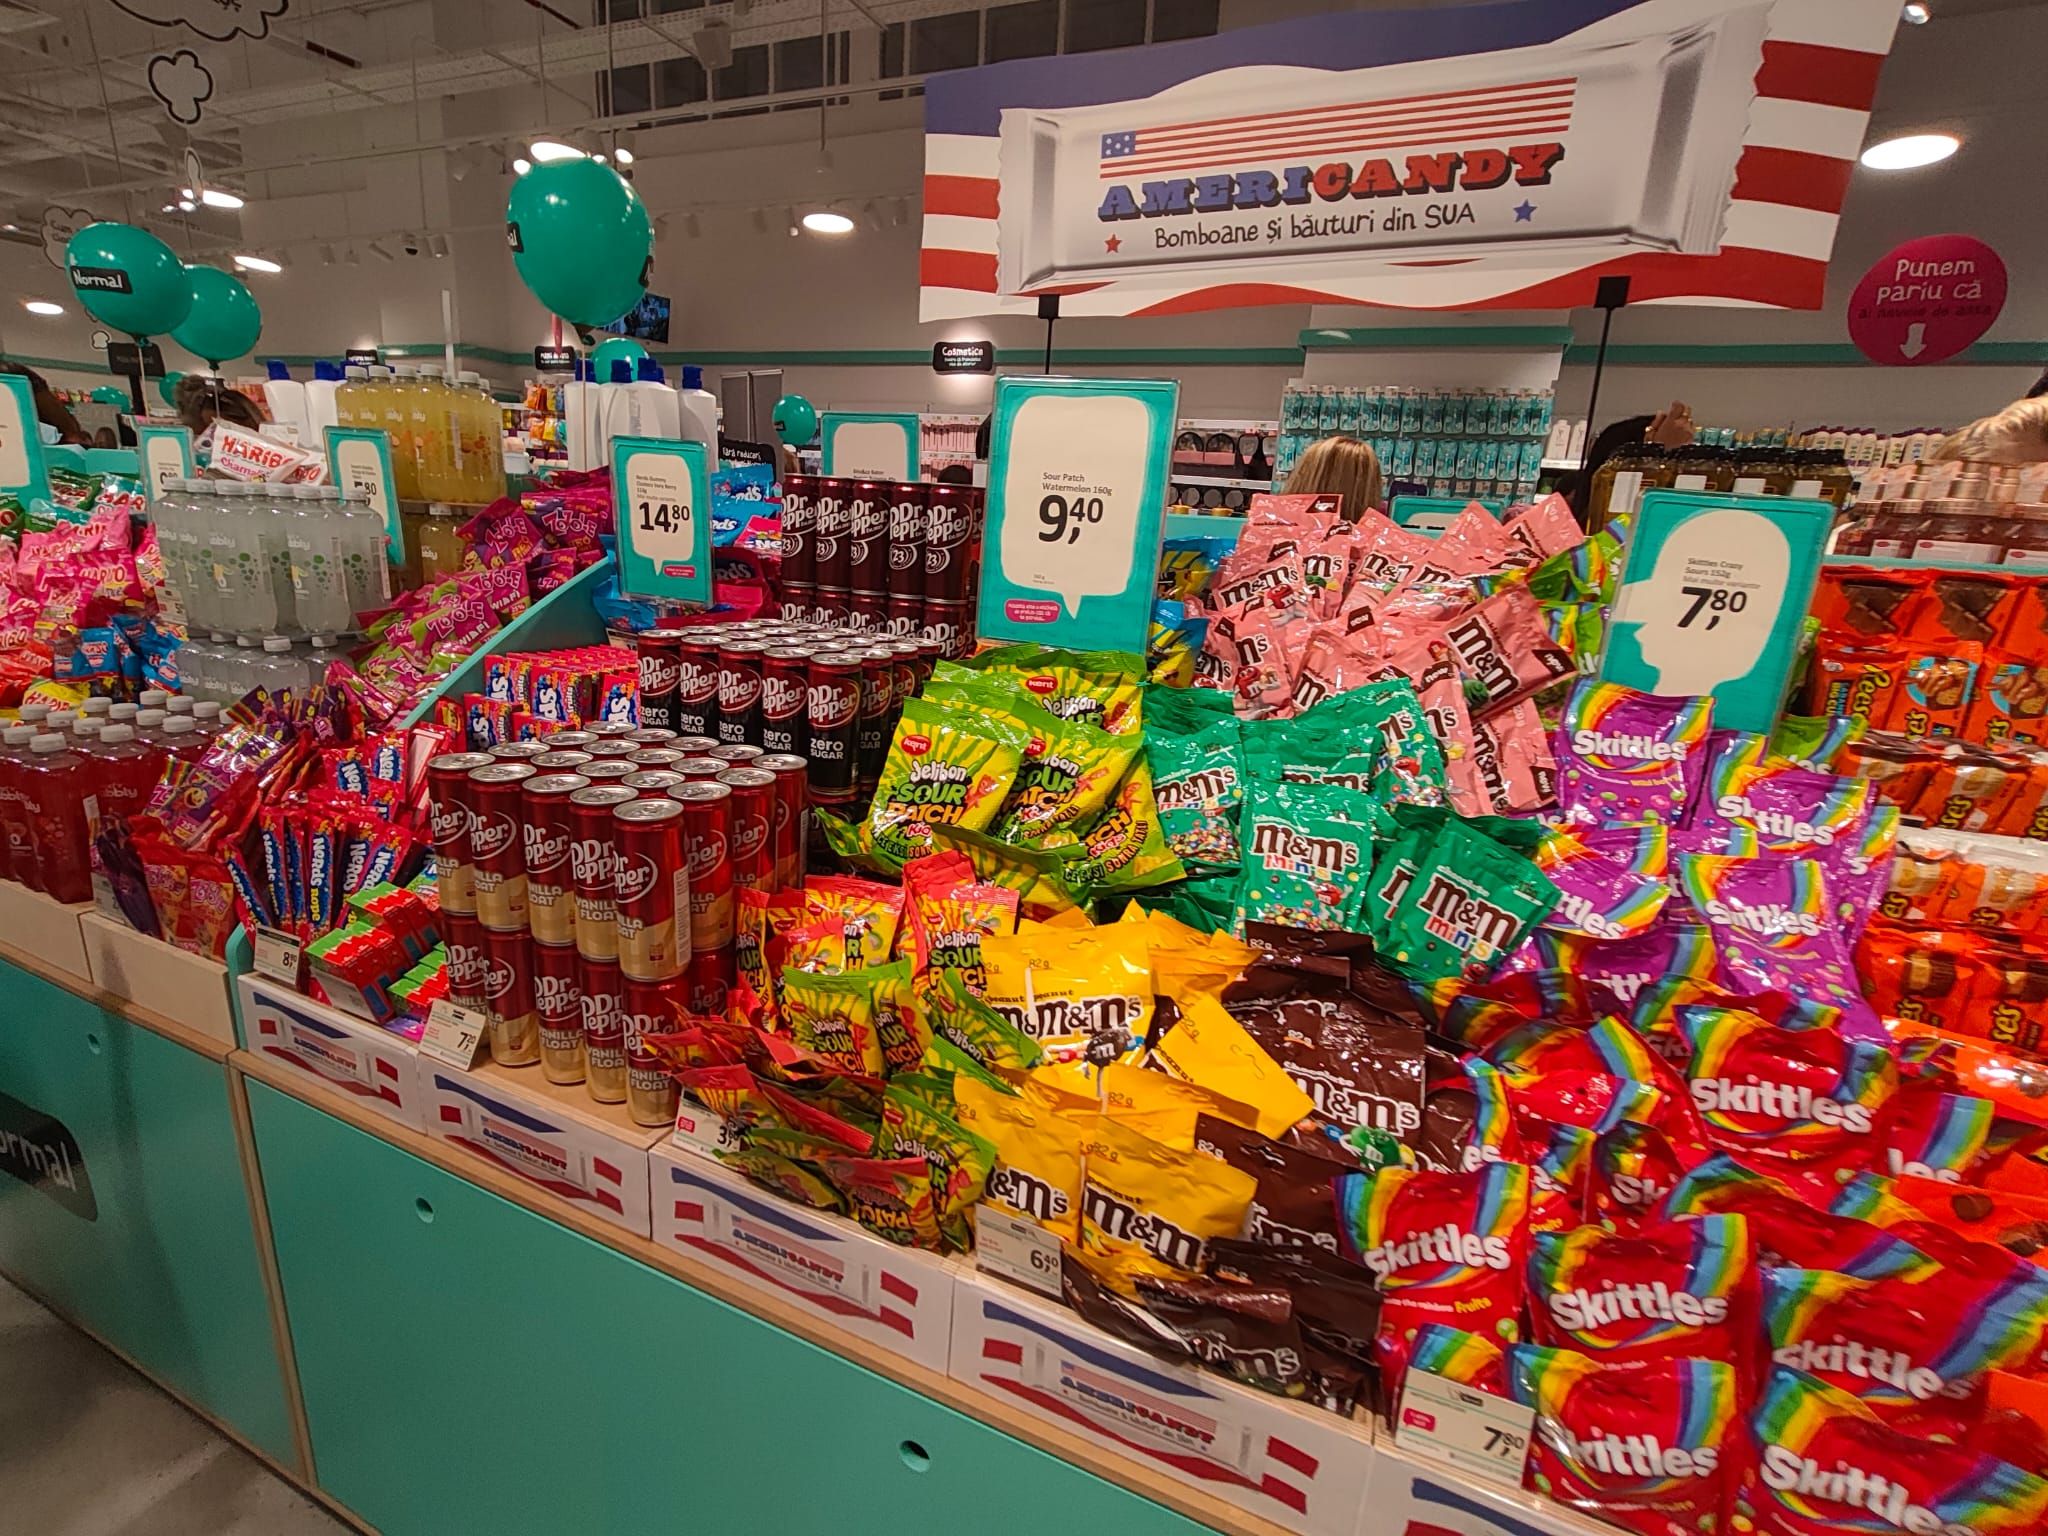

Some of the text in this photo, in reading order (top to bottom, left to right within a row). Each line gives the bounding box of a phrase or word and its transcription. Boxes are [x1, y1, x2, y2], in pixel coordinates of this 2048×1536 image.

[1098, 142, 1565, 221] AMERICANDY
[1156, 221, 1258, 248] Bomboane
[1291, 210, 1374, 238] băuturi
[1383, 206, 1416, 232] din
[1425, 202, 1475, 226] SUA
[74, 269, 122, 288] Normal
[1896, 259, 1974, 281] Punem
[1877, 282, 1942, 305] pariu
[1042, 483, 1113, 496] Watermelon 160g
[1043, 472, 1085, 482] Sour Patch
[639, 502, 690, 534] 14,80
[782, 507, 817, 531] eppe
[817, 510, 851, 535] eppe
[851, 508, 889, 538] epper
[1038, 494, 1104, 545] 9,40
[1677, 586, 1747, 631] 7,80
[639, 664, 679, 691] epper
[681, 670, 720, 698] pper
[1042, 698, 1098, 717] Jelibon
[681, 723, 704, 734] UGAR
[719, 731, 744, 743] UGAR
[763, 728, 791, 743] zero
[810, 737, 844, 752] zero
[811, 747, 844, 760] SUGAR
[904, 738, 928, 750] kent
[1572, 730, 1688, 761] Skittles
[910, 760, 967, 782] Jelibon
[897, 783, 967, 805] SOUR
[1718, 795, 1834, 846] Skttles
[471, 822, 509, 852] pper
[525, 832, 569, 867] pper
[363, 851, 391, 890] Nerd
[570, 842, 614, 884] Pepp
[575, 898, 617, 911] VANIL
[935, 930, 981, 949] Jelibon
[1424, 916, 1491, 959] minis
[931, 949, 983, 969] SOUR
[930, 968, 987, 991] PTCH
[581, 996, 624, 1034] Pepp
[592, 1056, 624, 1068] FLOA
[1690, 1074, 1874, 1134] Skittles
[893, 1133, 946, 1168] Jelibon
[1030, 1249, 1059, 1273] 6,40
[1365, 1223, 1511, 1290] Skittles
[1550, 1280, 1728, 1331] Skittles
[1484, 1426, 1525, 1457] 7,80
